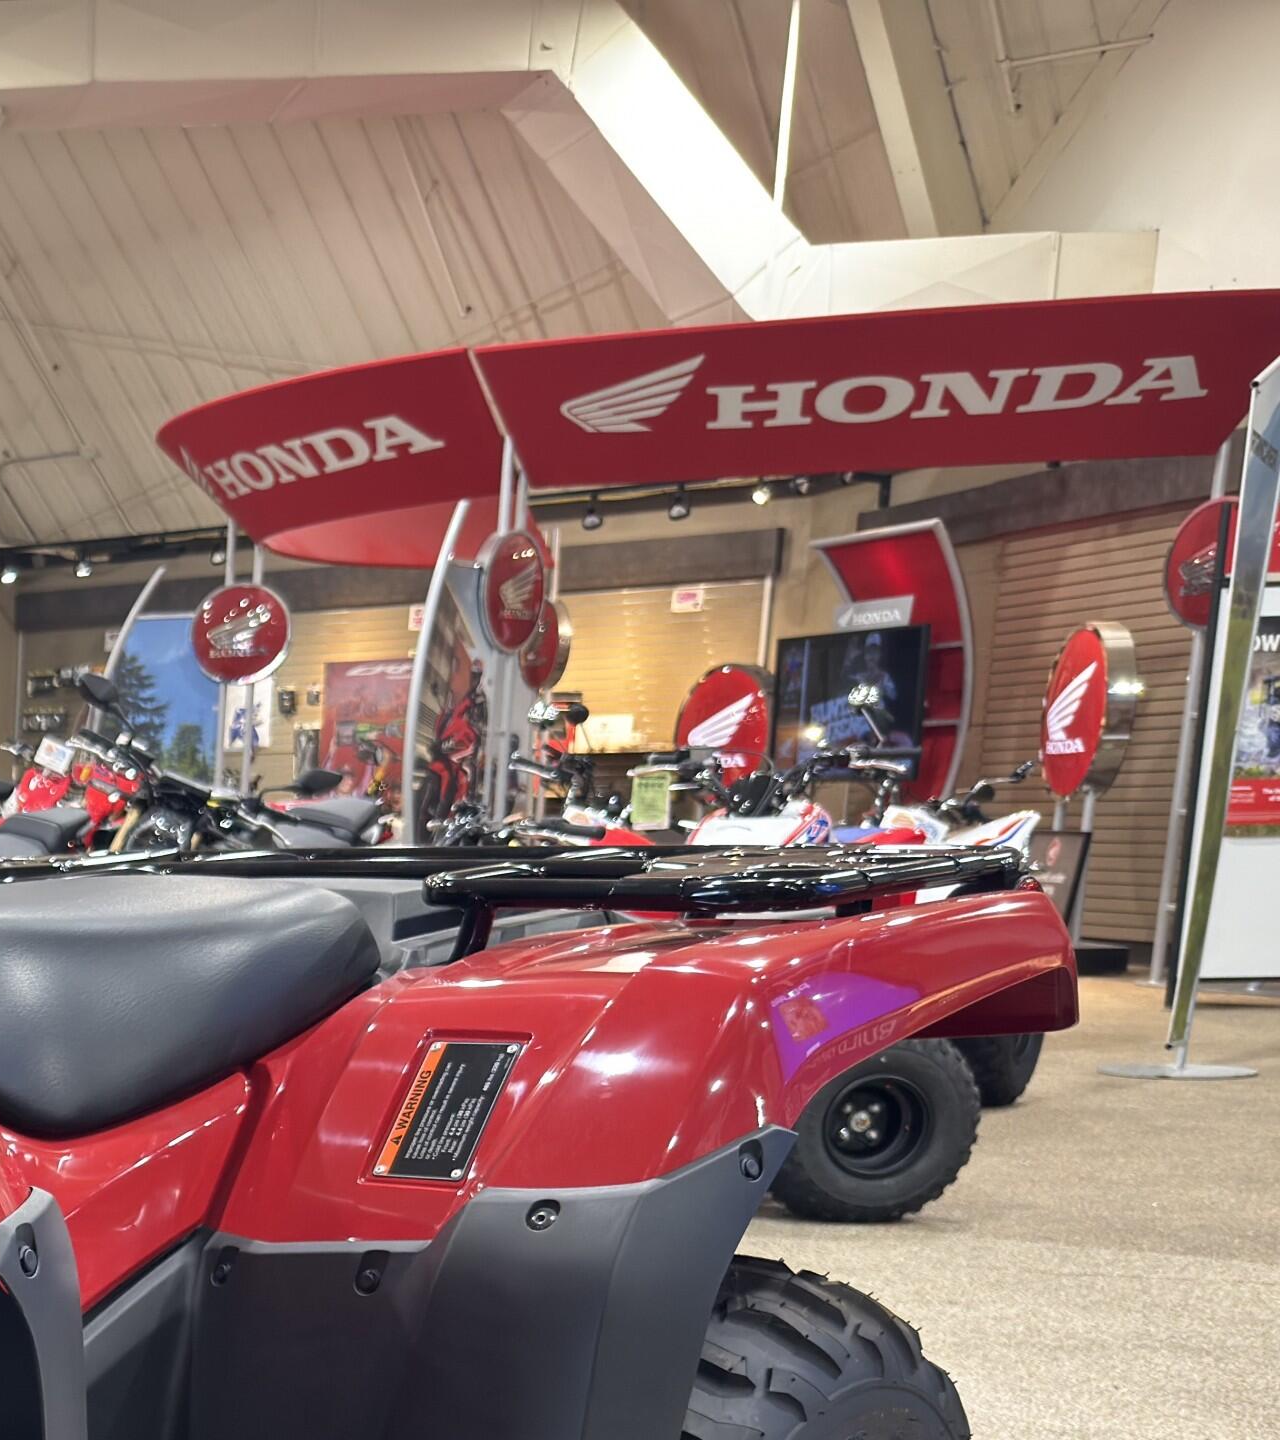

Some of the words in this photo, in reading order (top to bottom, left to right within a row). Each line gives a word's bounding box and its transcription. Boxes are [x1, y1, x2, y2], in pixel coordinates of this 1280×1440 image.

[706, 354, 1208, 429] HONDA
[204, 414, 445, 500] HONDA
[852, 607, 902, 625] HONDA
[1046, 738, 1086, 755] HONDA
[397, 1070, 432, 1129] WARNING
